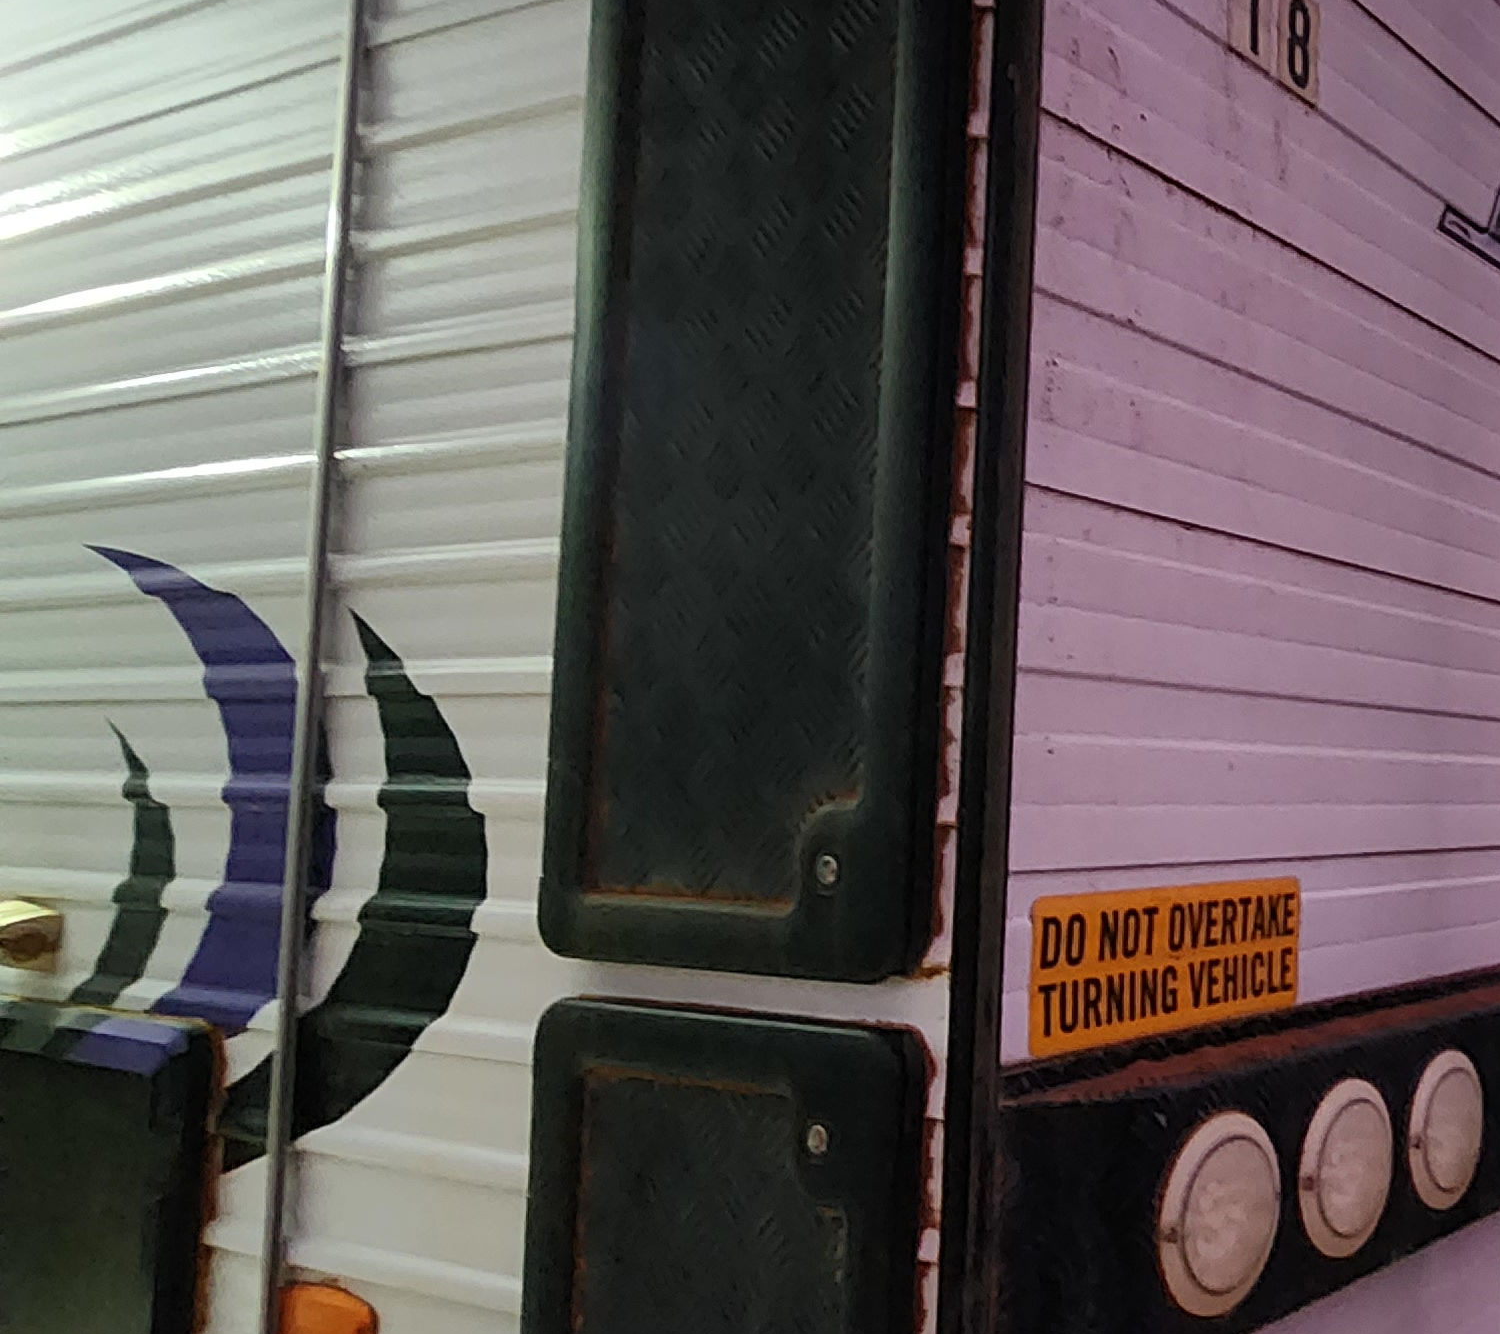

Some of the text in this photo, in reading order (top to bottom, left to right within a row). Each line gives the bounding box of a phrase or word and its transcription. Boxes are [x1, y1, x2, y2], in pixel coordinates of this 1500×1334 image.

[1039, 892, 1295, 969] DO NOT OVERTAKE
[1038, 947, 1294, 1037] TURNING VEHICLE
